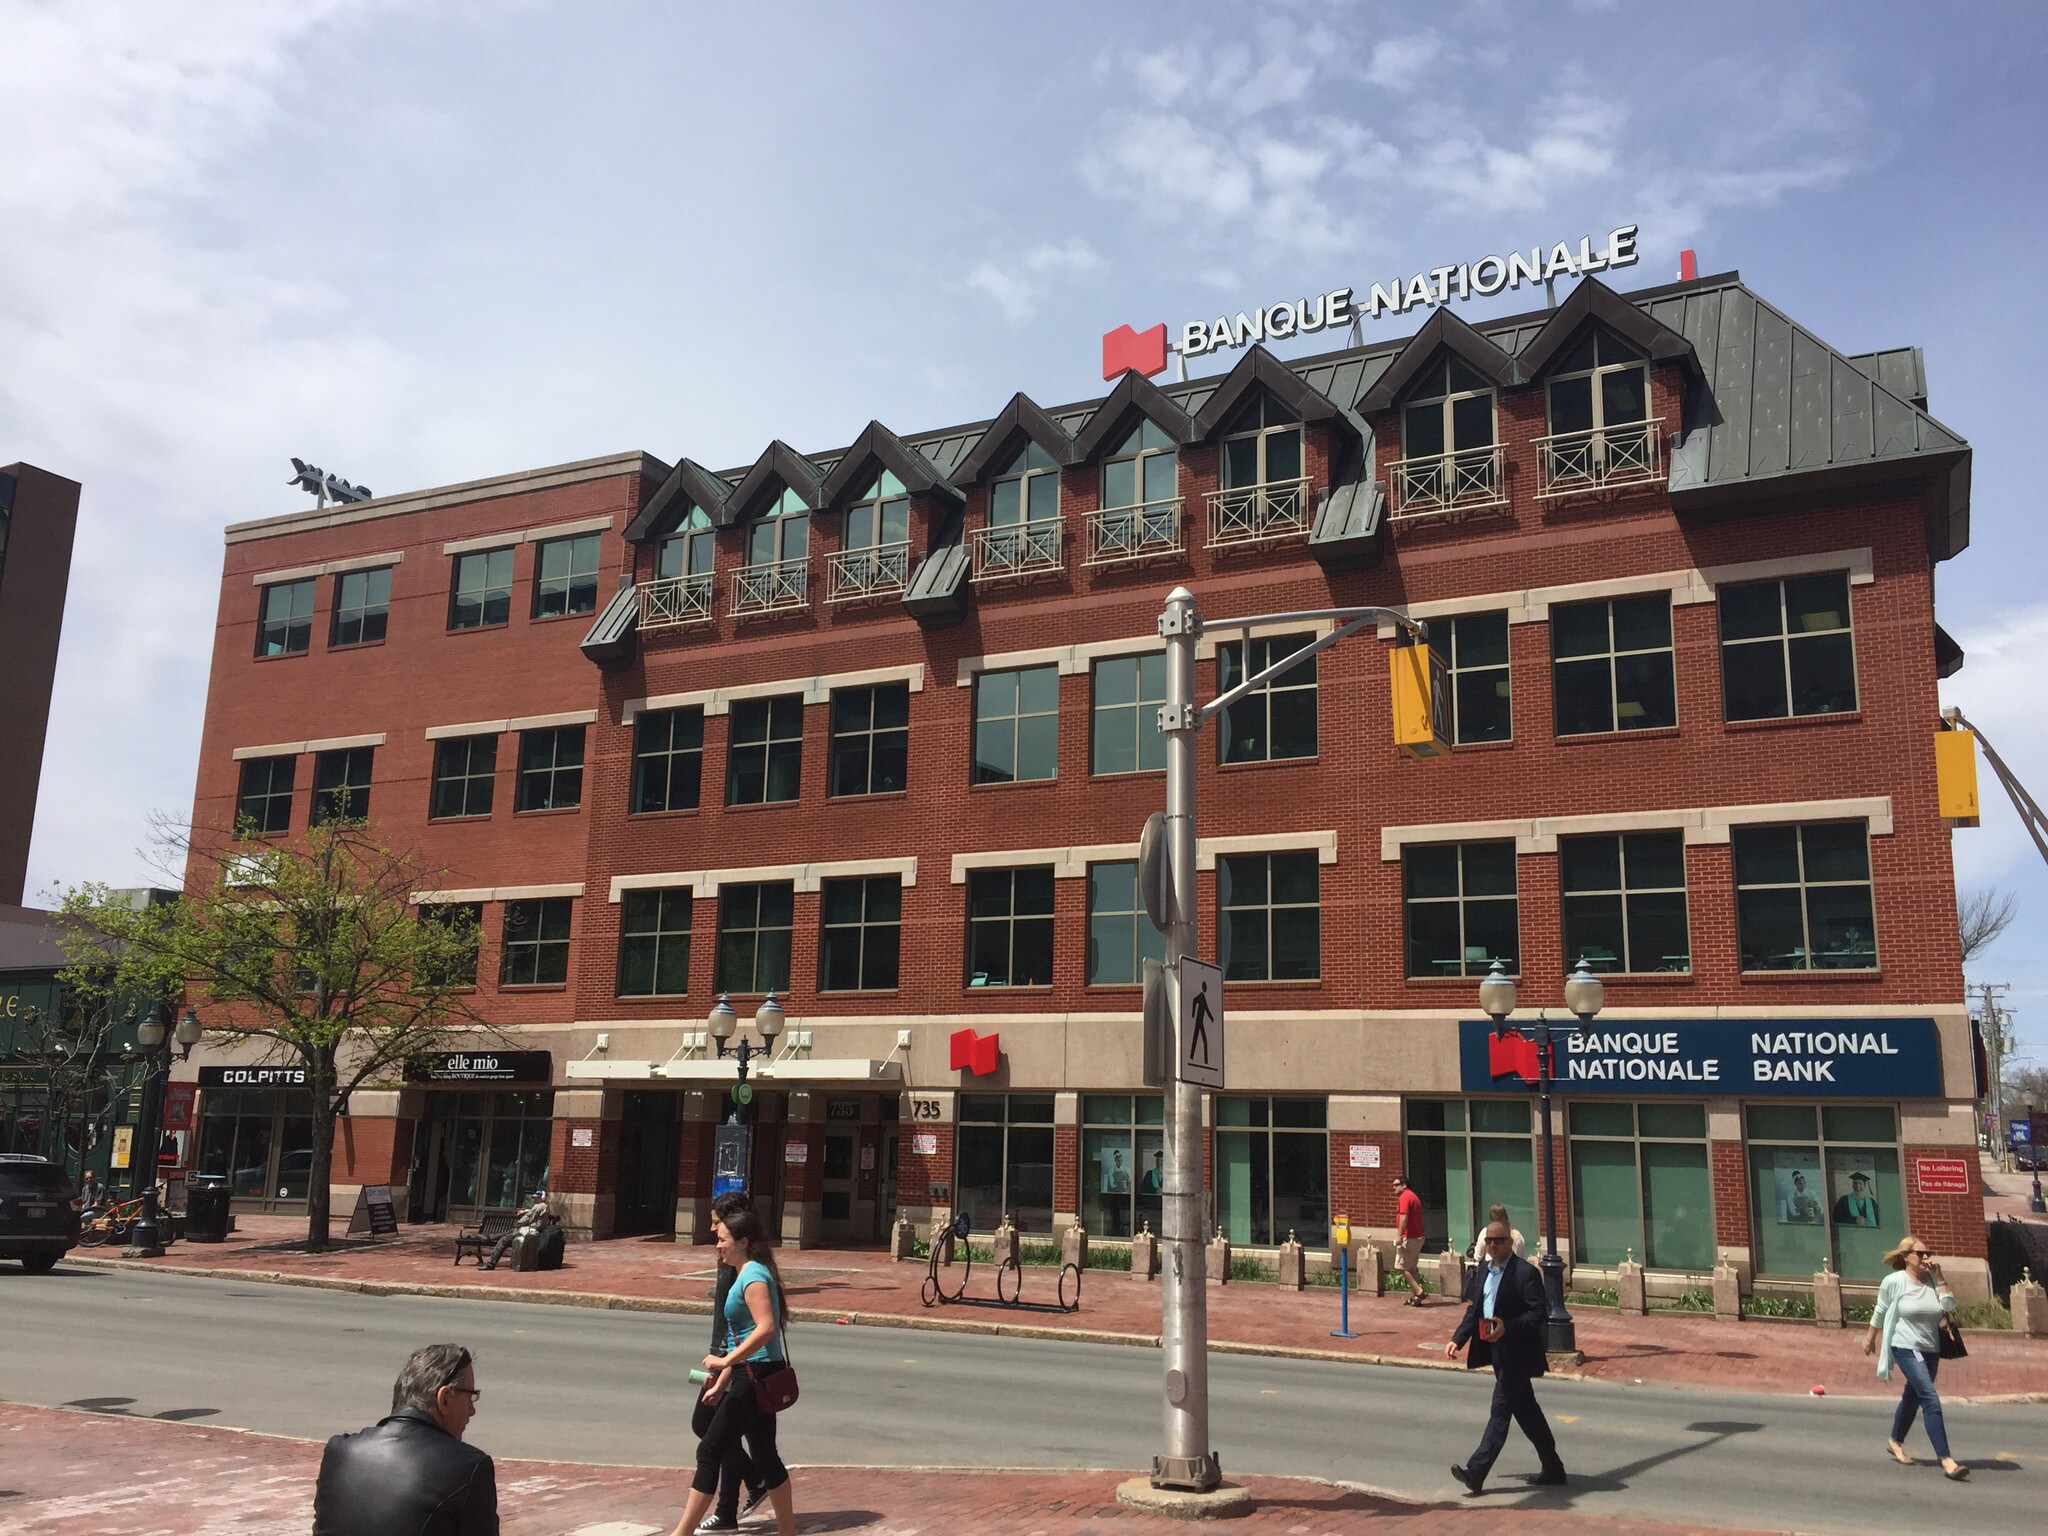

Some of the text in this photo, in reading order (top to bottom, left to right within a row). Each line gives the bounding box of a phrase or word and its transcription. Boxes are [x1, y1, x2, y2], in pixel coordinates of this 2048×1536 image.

[1182, 224, 1639, 358] BANQUE NATIONALE
[1567, 1032, 1899, 1055] BANQUE NATIONAL
[447, 1054, 498, 1070] elle mio
[1568, 1059, 1836, 1082] NATIONALE BANK
[223, 1070, 305, 1083] COLPITTS
[912, 1101, 941, 1119] 735
[1932, 1165, 1964, 1173] Loitering
